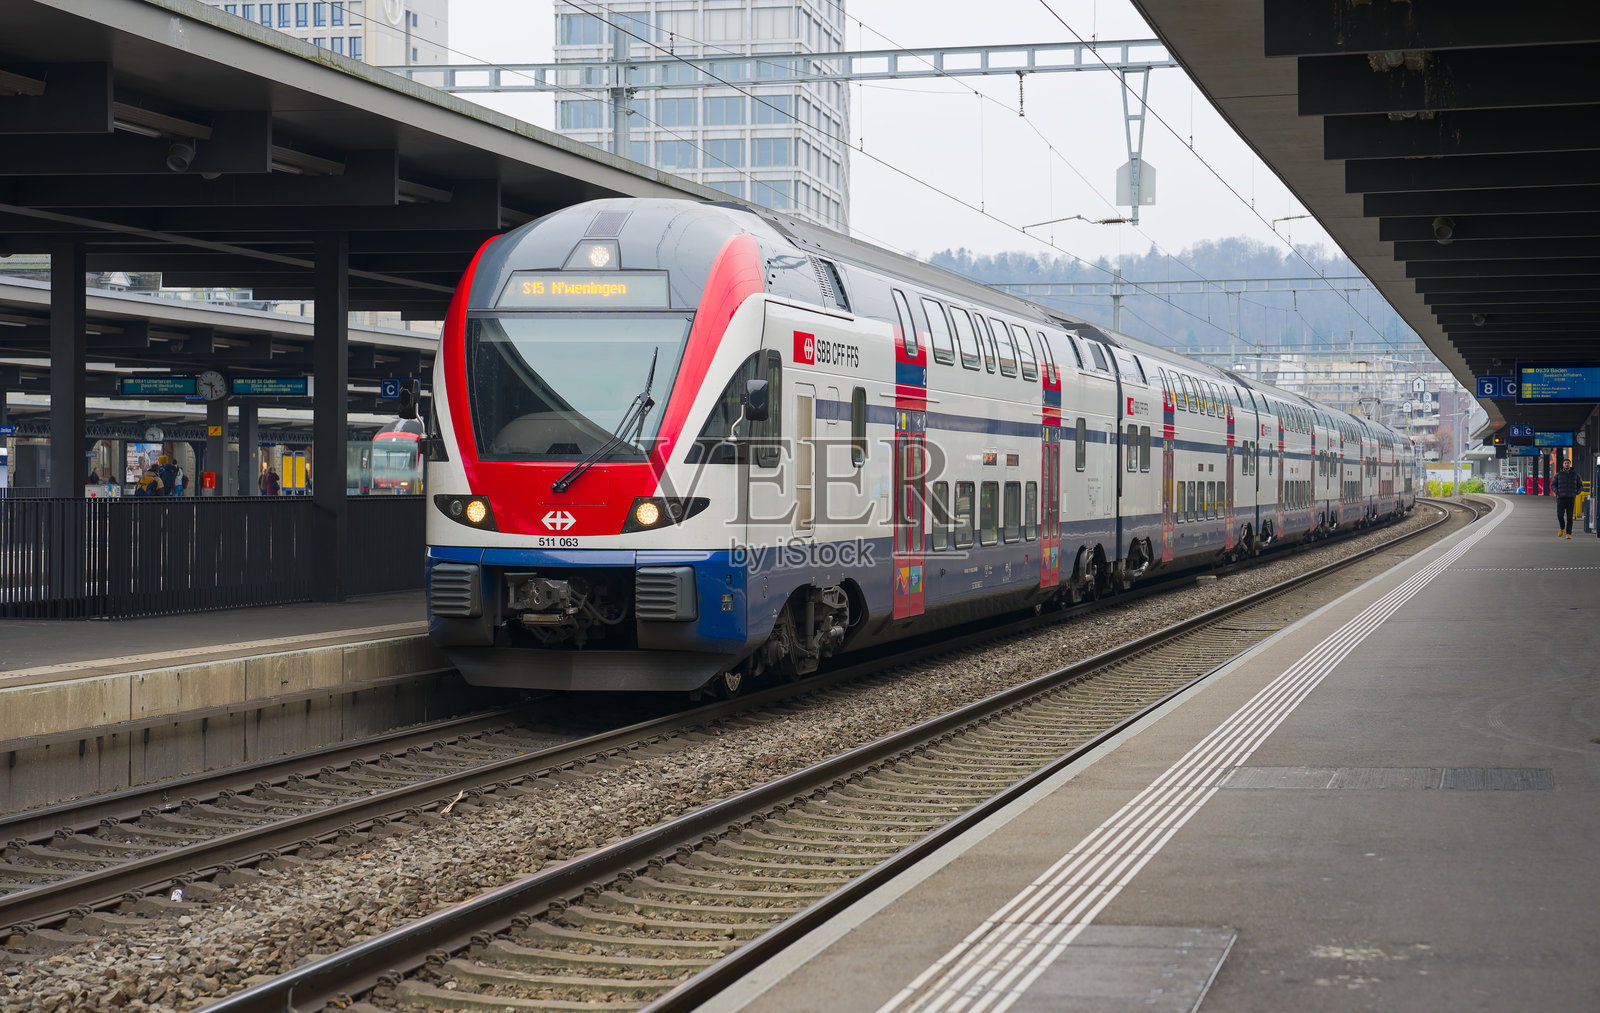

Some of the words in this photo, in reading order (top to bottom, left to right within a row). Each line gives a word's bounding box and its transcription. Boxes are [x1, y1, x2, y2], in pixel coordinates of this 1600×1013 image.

[522, 282, 545, 295] S15
[552, 281, 627, 297] N'weningen
[816, 339, 832, 363] SBB
[832, 342, 846, 366] CFF
[846, 345, 860, 368] FFS
[922, 368, 927, 386] 2
[386, 384, 395, 395] C
[1484, 383, 1493, 394] 8
[1507, 383, 1517, 394] C
[538, 537, 556, 547] 511
[559, 537, 579, 547] 063
